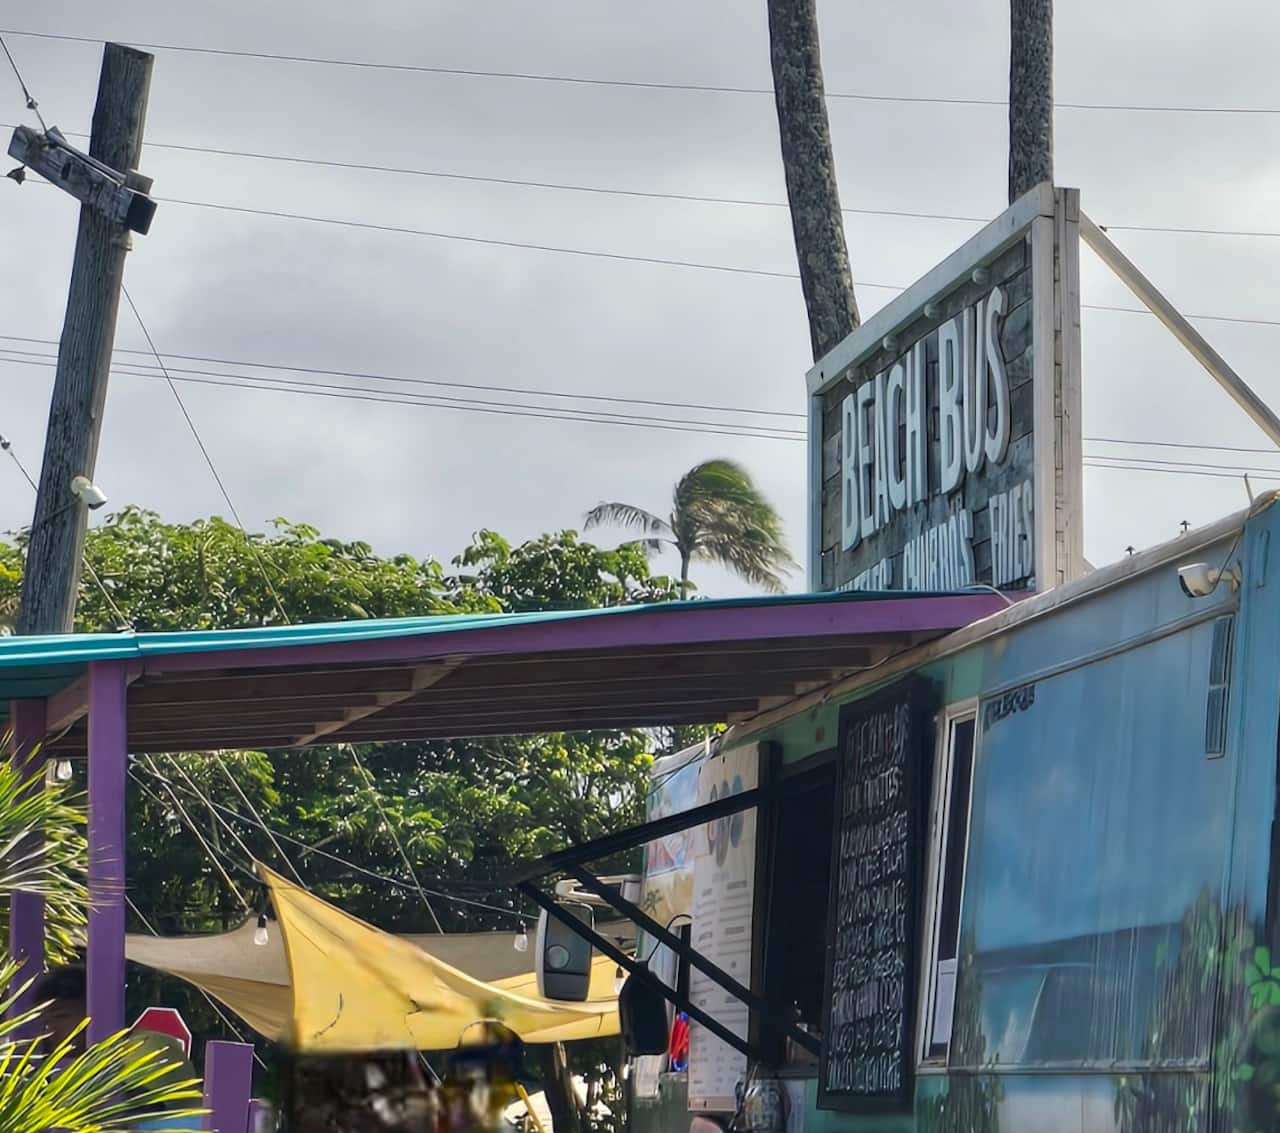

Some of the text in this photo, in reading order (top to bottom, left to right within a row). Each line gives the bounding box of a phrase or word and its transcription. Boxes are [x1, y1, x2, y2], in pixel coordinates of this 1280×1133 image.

[842, 286, 1010, 552] BEACH BUS
[989, 480, 1034, 587] FRIES
